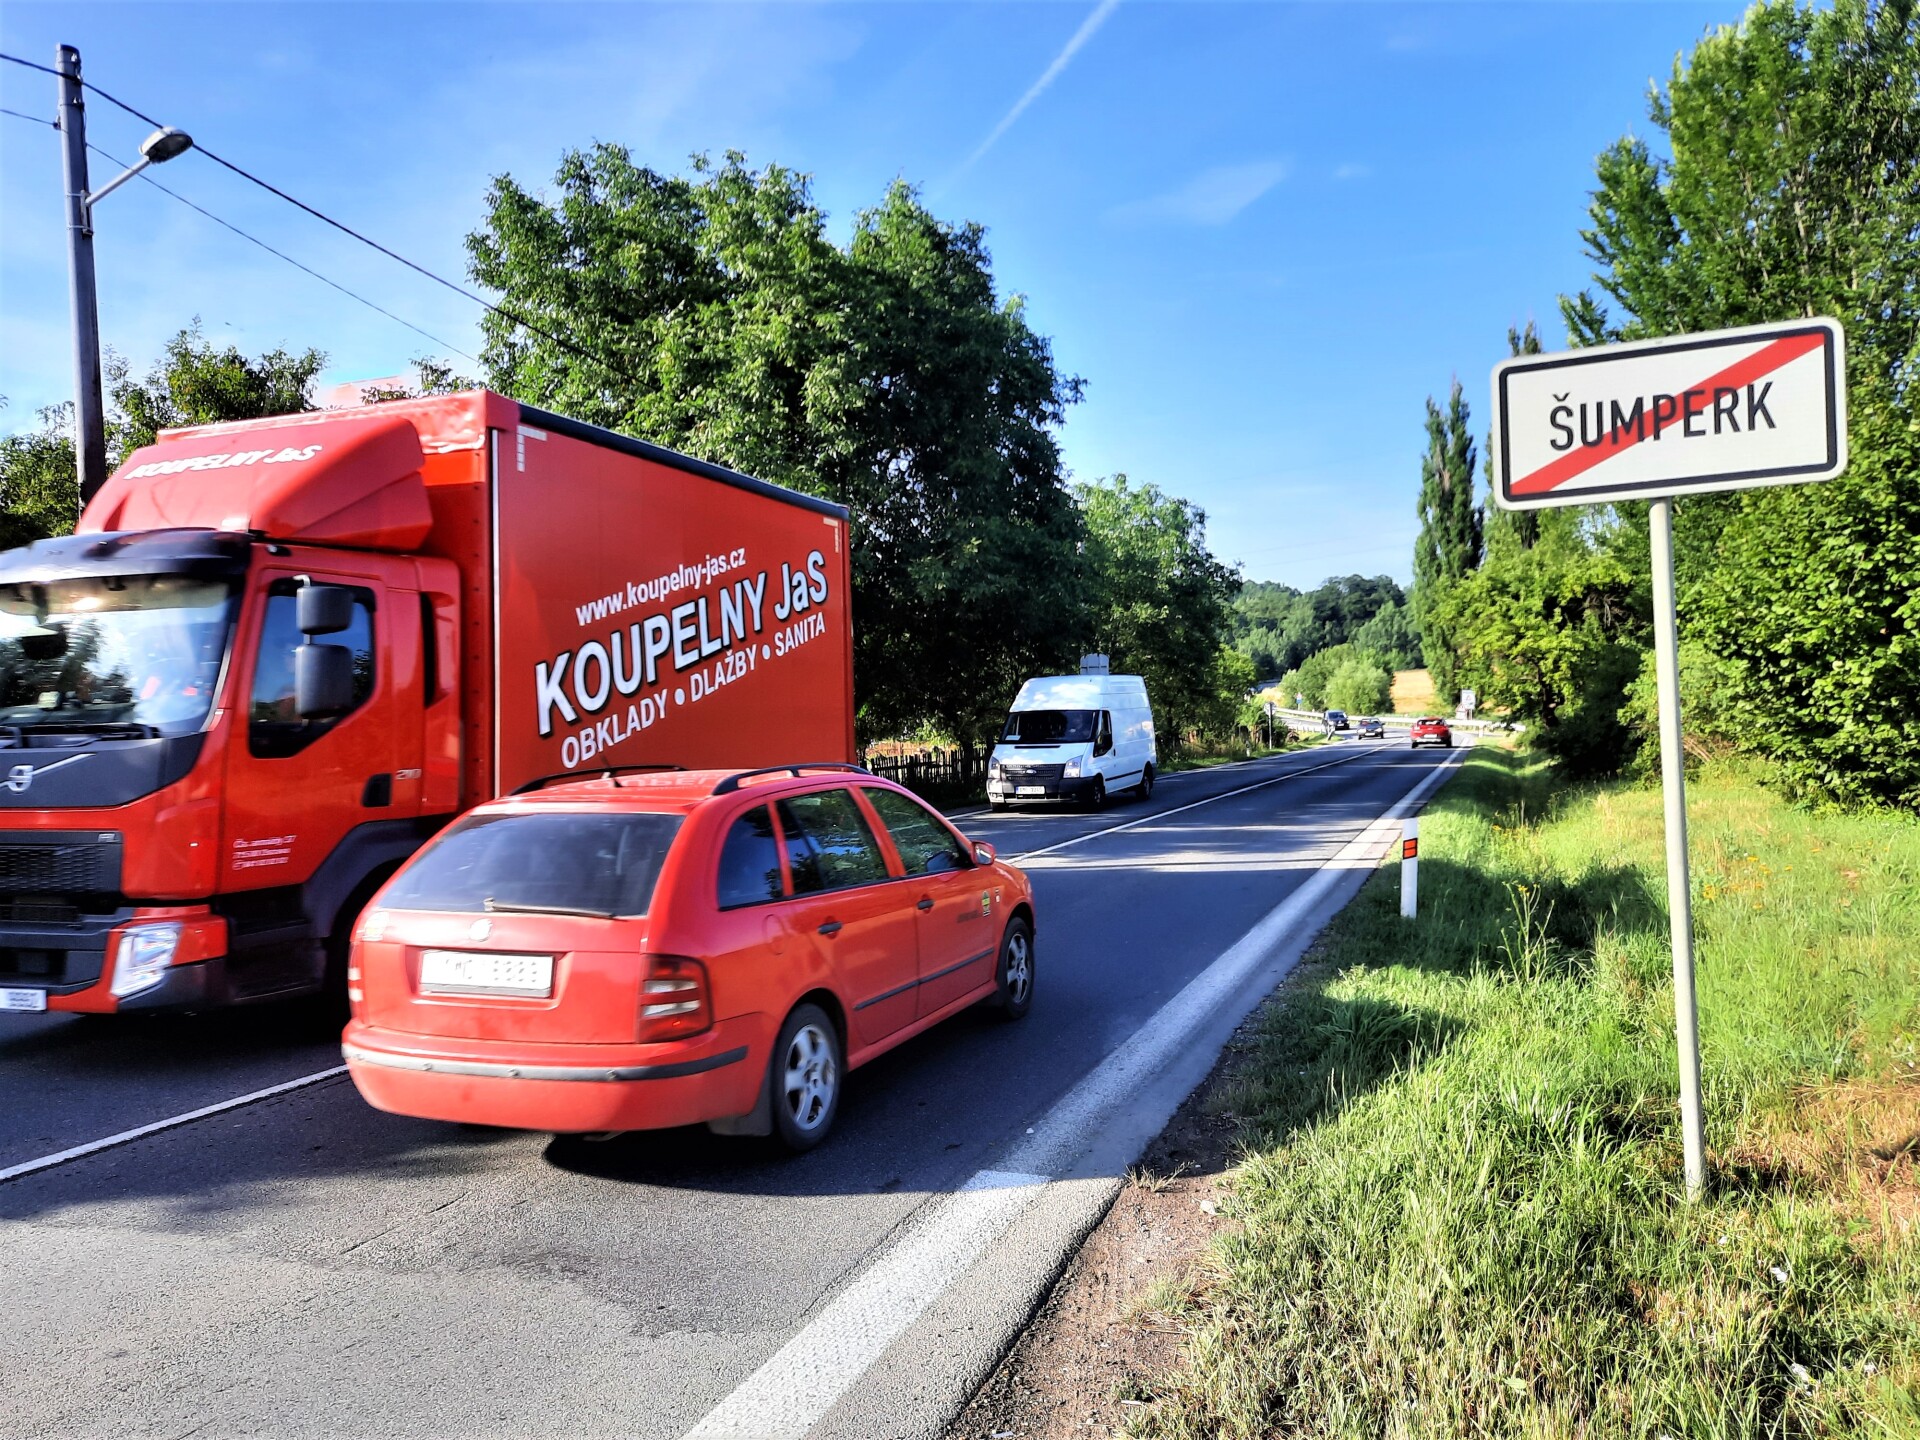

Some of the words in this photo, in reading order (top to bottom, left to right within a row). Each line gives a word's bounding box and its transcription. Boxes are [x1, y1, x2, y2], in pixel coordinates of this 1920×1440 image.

[1549, 381, 1777, 452] ŠUMPERK
[123, 449, 274, 480] KOUPELNY
[263, 444, 323, 464] JaS
[575, 547, 747, 627] www.koupelny-jas.cz
[535, 571, 768, 737] KOUPELNY
[774, 549, 829, 622] JaS
[560, 689, 668, 769] OBKLADY
[690, 645, 758, 703] DLAŽBY
[773, 611, 826, 657] SANITA
